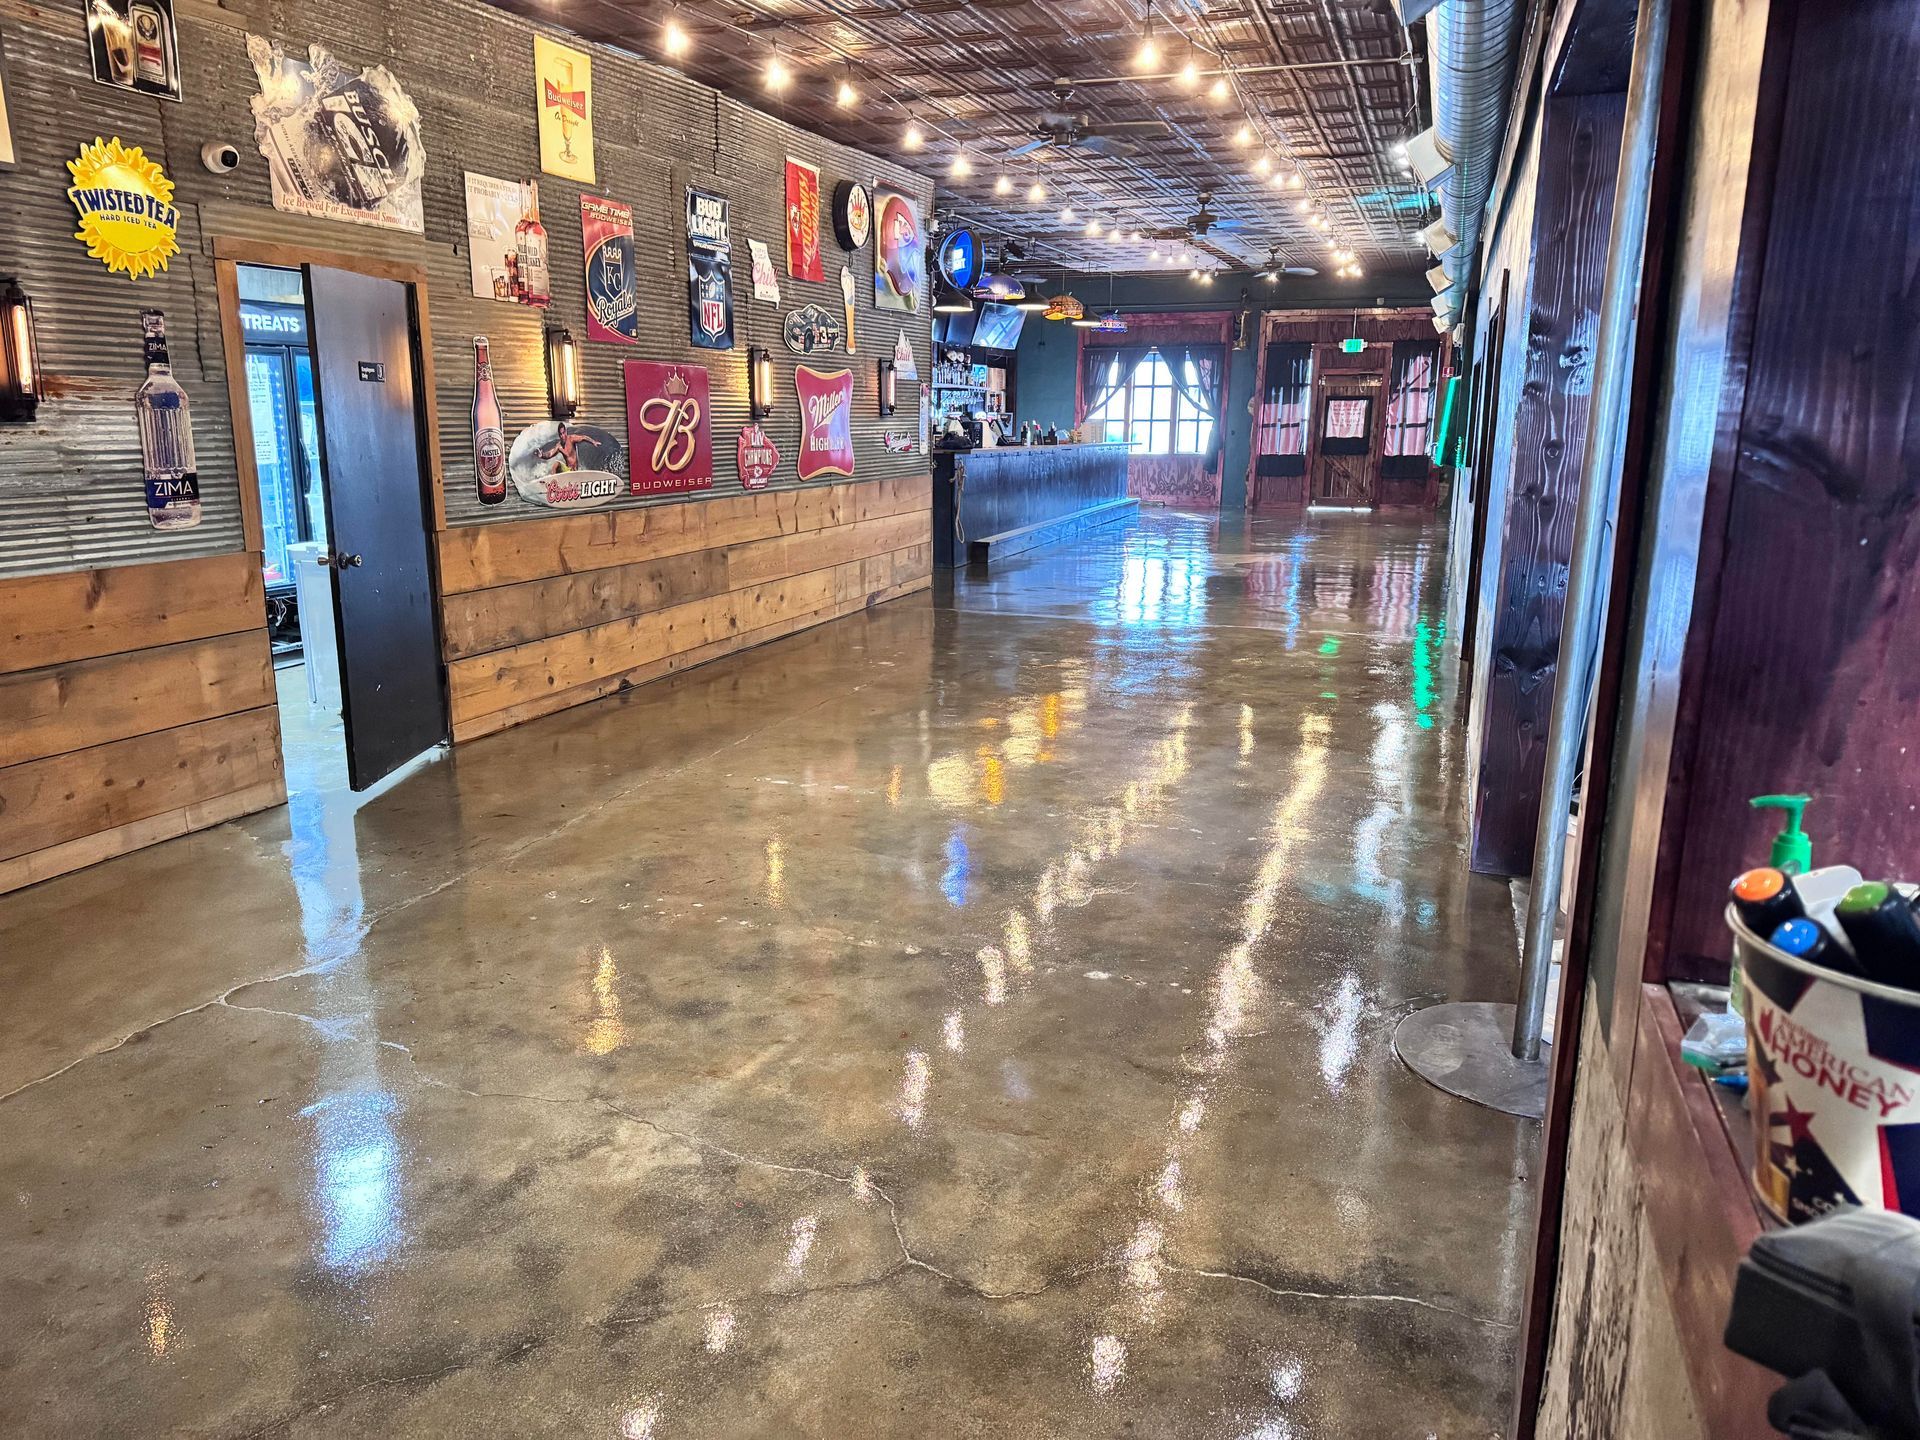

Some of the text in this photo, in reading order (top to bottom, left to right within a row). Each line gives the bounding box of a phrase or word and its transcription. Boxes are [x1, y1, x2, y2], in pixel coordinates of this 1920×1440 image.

[547, 89, 585, 110] Budweiser
[343, 91, 396, 186] BUSCH
[72, 188, 176, 229] TWISTED TEA
[282, 194, 294, 206] Ice
[296, 197, 324, 211] Brewed
[325, 202, 340, 214] For
[341, 205, 380, 222] Exceptional
[581, 202, 630, 219] GAME TIME
[590, 212, 633, 227] BUDWEISER
[696, 196, 722, 220] BUD
[100, 214, 157, 230] HARD ICED TEA
[691, 213, 728, 241] LIGHT
[606, 265, 621, 291] KC
[596, 290, 635, 328] Royals
[703, 302, 725, 331] NFL
[240, 313, 300, 333] TREATS
[148, 343, 167, 351] ZIMA
[808, 385, 847, 428] Miller
[810, 432, 829, 452] HIGH
[153, 481, 194, 496] ZIMA
[546, 479, 617, 503] Coors LIGHT
[632, 477, 712, 491] BUDWEISER
[1773, 1023, 1913, 1103] AMERICAN
[1771, 1034, 1902, 1118] HONEY
